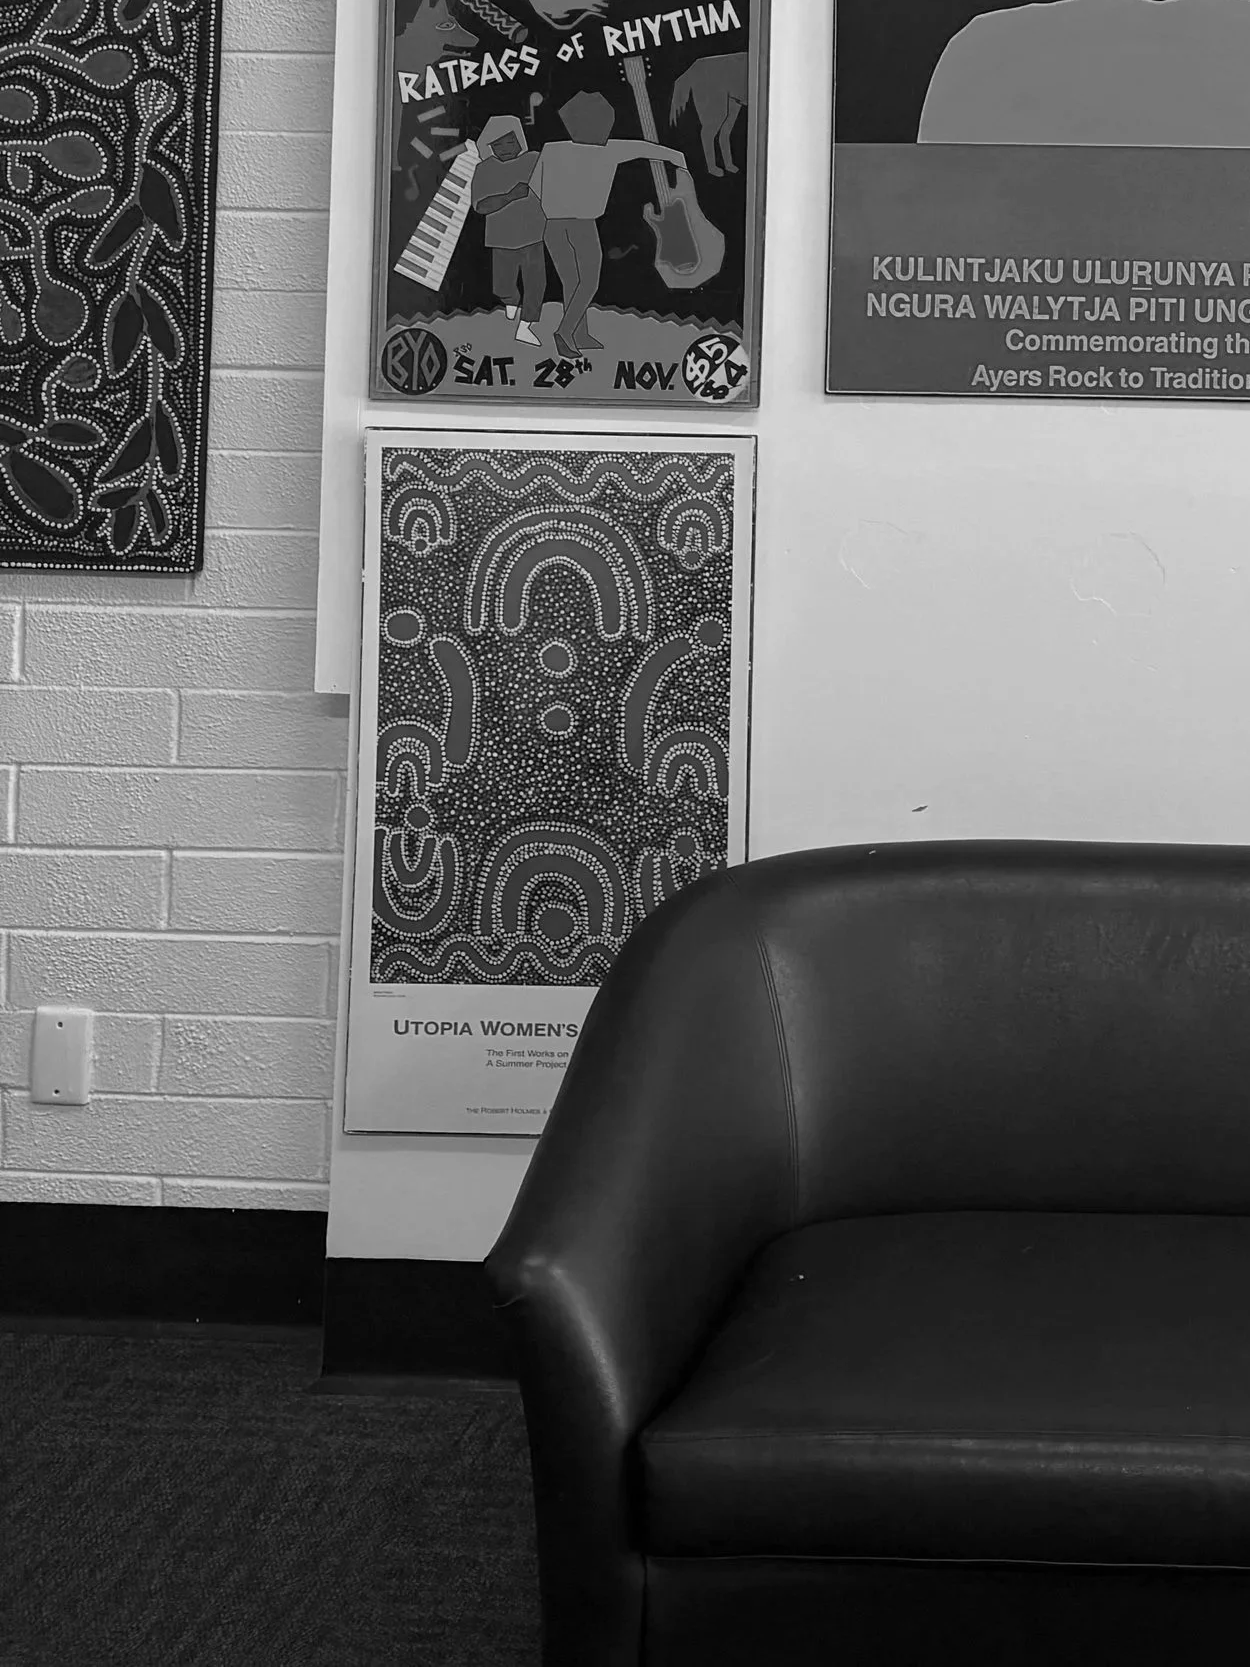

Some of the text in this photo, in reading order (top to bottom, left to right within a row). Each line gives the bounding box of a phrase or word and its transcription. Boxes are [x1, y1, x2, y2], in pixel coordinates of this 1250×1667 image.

[398, 45, 540, 103] RATBAGS
[603, 0, 742, 57] RHYTHM
[873, 256, 1064, 283] KULINTJAKU
[867, 292, 977, 319] NGURA
[985, 294, 1121, 322] WALYTJA
[1129, 297, 1185, 322] PITI
[1005, 328, 1217, 359] Commemorating
[453, 355, 679, 391] SAT. 28th NOV.
[971, 363, 1042, 392] Ayers
[1048, 365, 1113, 389] Rock
[1119, 368, 1144, 389] to
[393, 1019, 579, 1038] UTOPIA WOMEN'S
[486, 1048, 504, 1057] The
[506, 1049, 525, 1058] First
[527, 1050, 555, 1058] Works
[486, 1059, 567, 1069] A Summer Project
